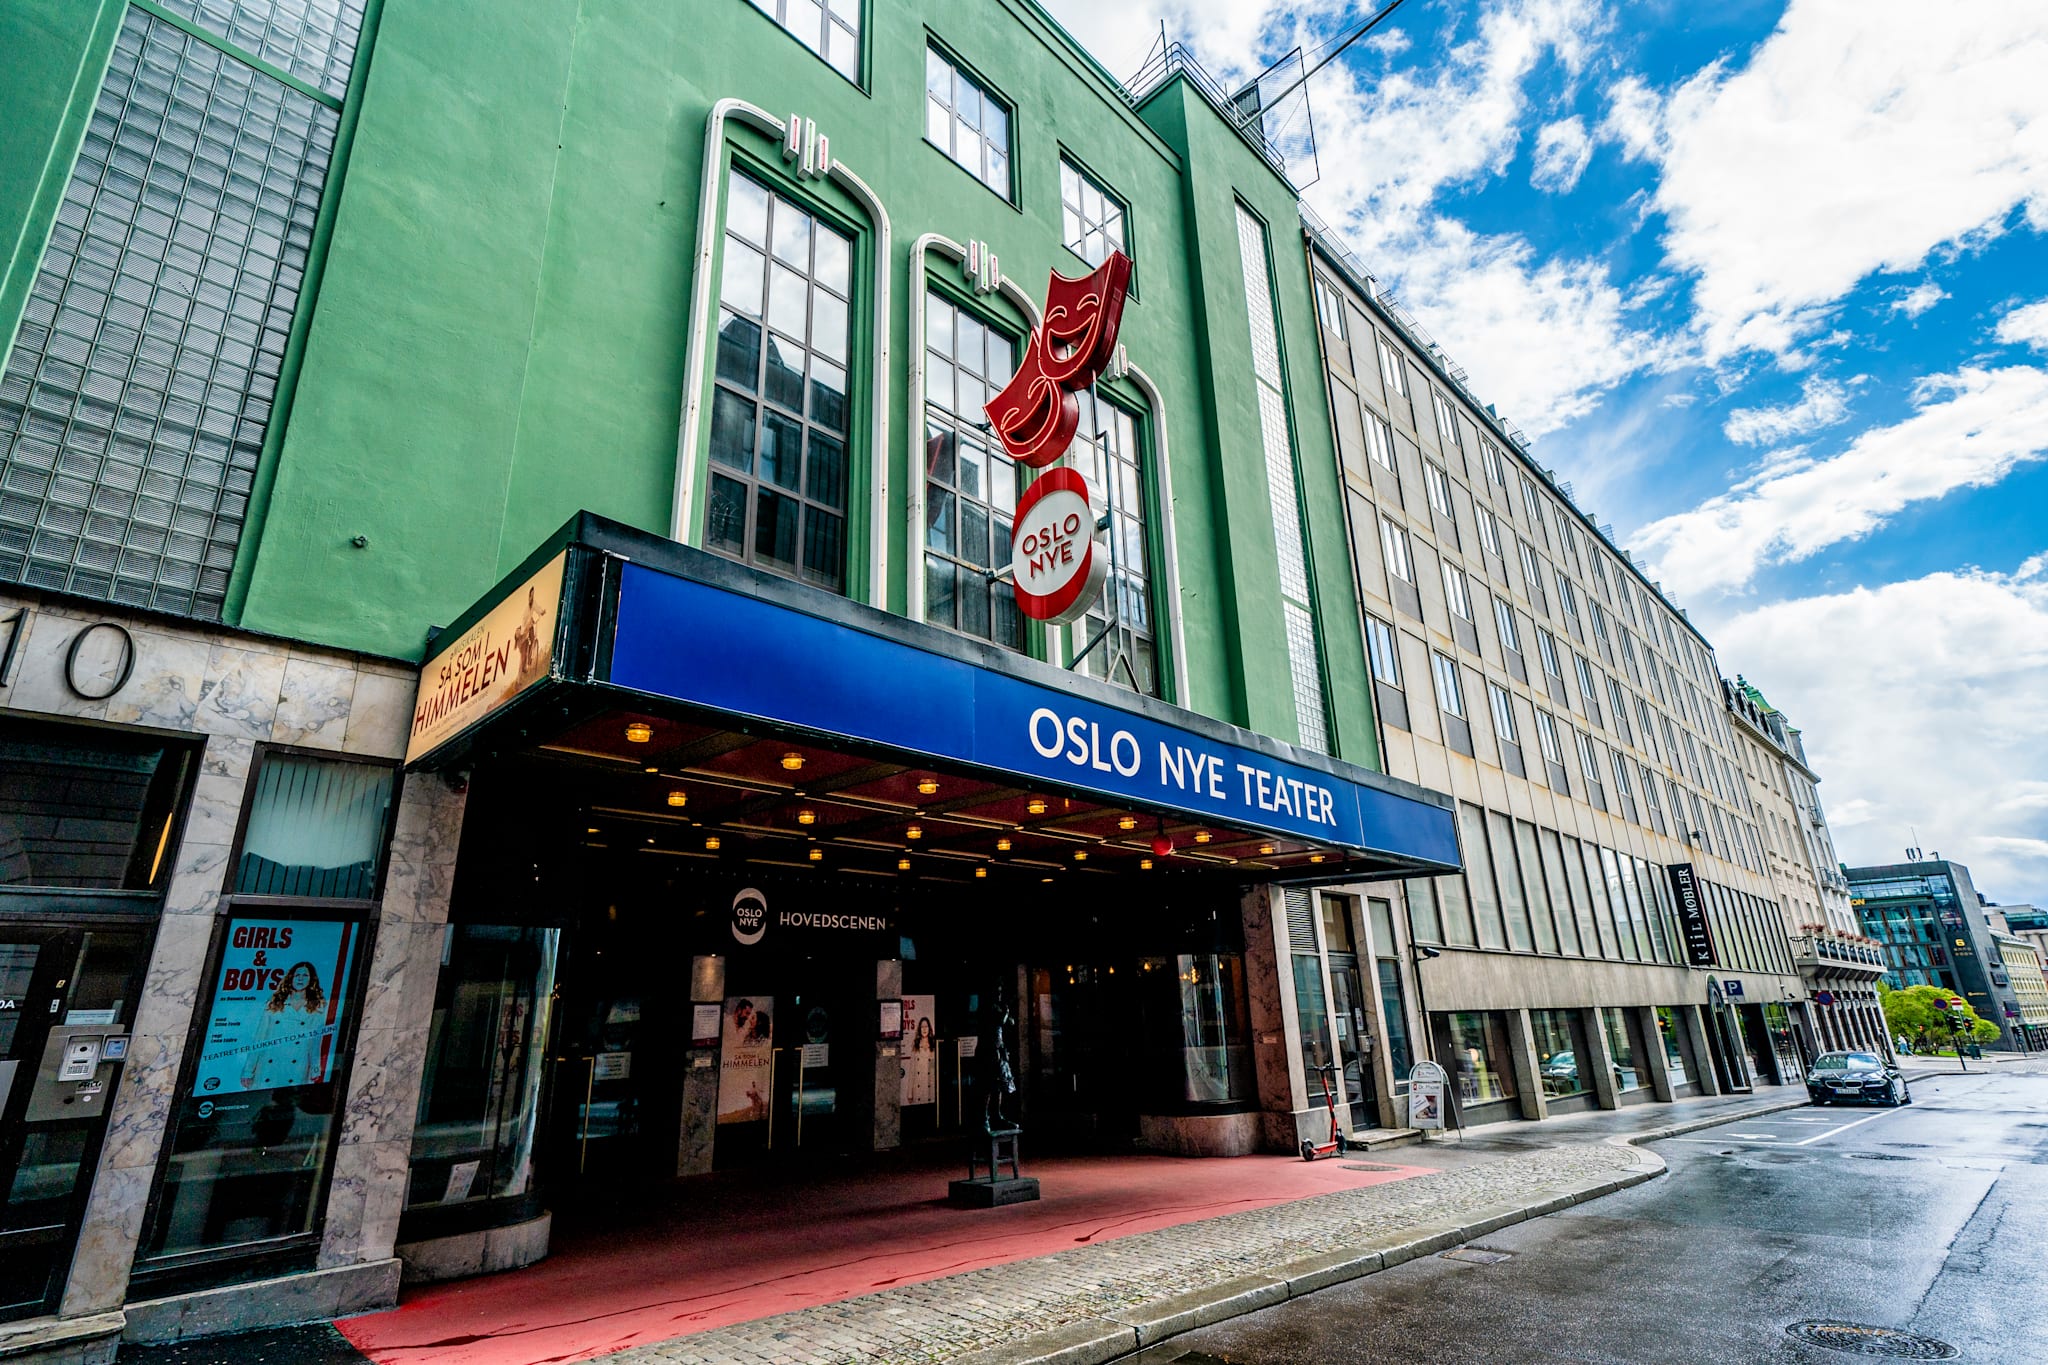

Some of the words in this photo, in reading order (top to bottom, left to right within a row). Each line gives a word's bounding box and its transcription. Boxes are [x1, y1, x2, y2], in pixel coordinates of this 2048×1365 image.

[1022, 513, 1080, 556] OSLO
[1030, 539, 1074, 579] NYE
[0, 607, 136, 701] 10
[455, 636, 483, 677] SOM
[485, 631, 490, 656] I
[413, 639, 511, 737] HIMMELEN
[1028, 707, 1141, 778] OSLO
[1159, 741, 1226, 800] NYE
[1236, 763, 1337, 827] TEATER
[1678, 868, 1700, 919] MØBLER
[736, 908, 762, 918] OSLO
[739, 918, 758, 927] NYE
[780, 911, 886, 930] HOVEDSCENEN
[232, 926, 293, 949] GIRLS
[1955, 938, 1966, 947] 6
[253, 950, 267, 967] &
[222, 968, 285, 991] BOYS
[1727, 982, 1738, 994] P
[902, 1019, 915, 1030] OYS
[203, 1048, 239, 1062] TEATRET
[240, 1045, 251, 1053] ER
[252, 1039, 282, 1051] LUKKET
[319, 1025, 338, 1036] JUNI
[722, 1058, 770, 1068] HIMMELEN
